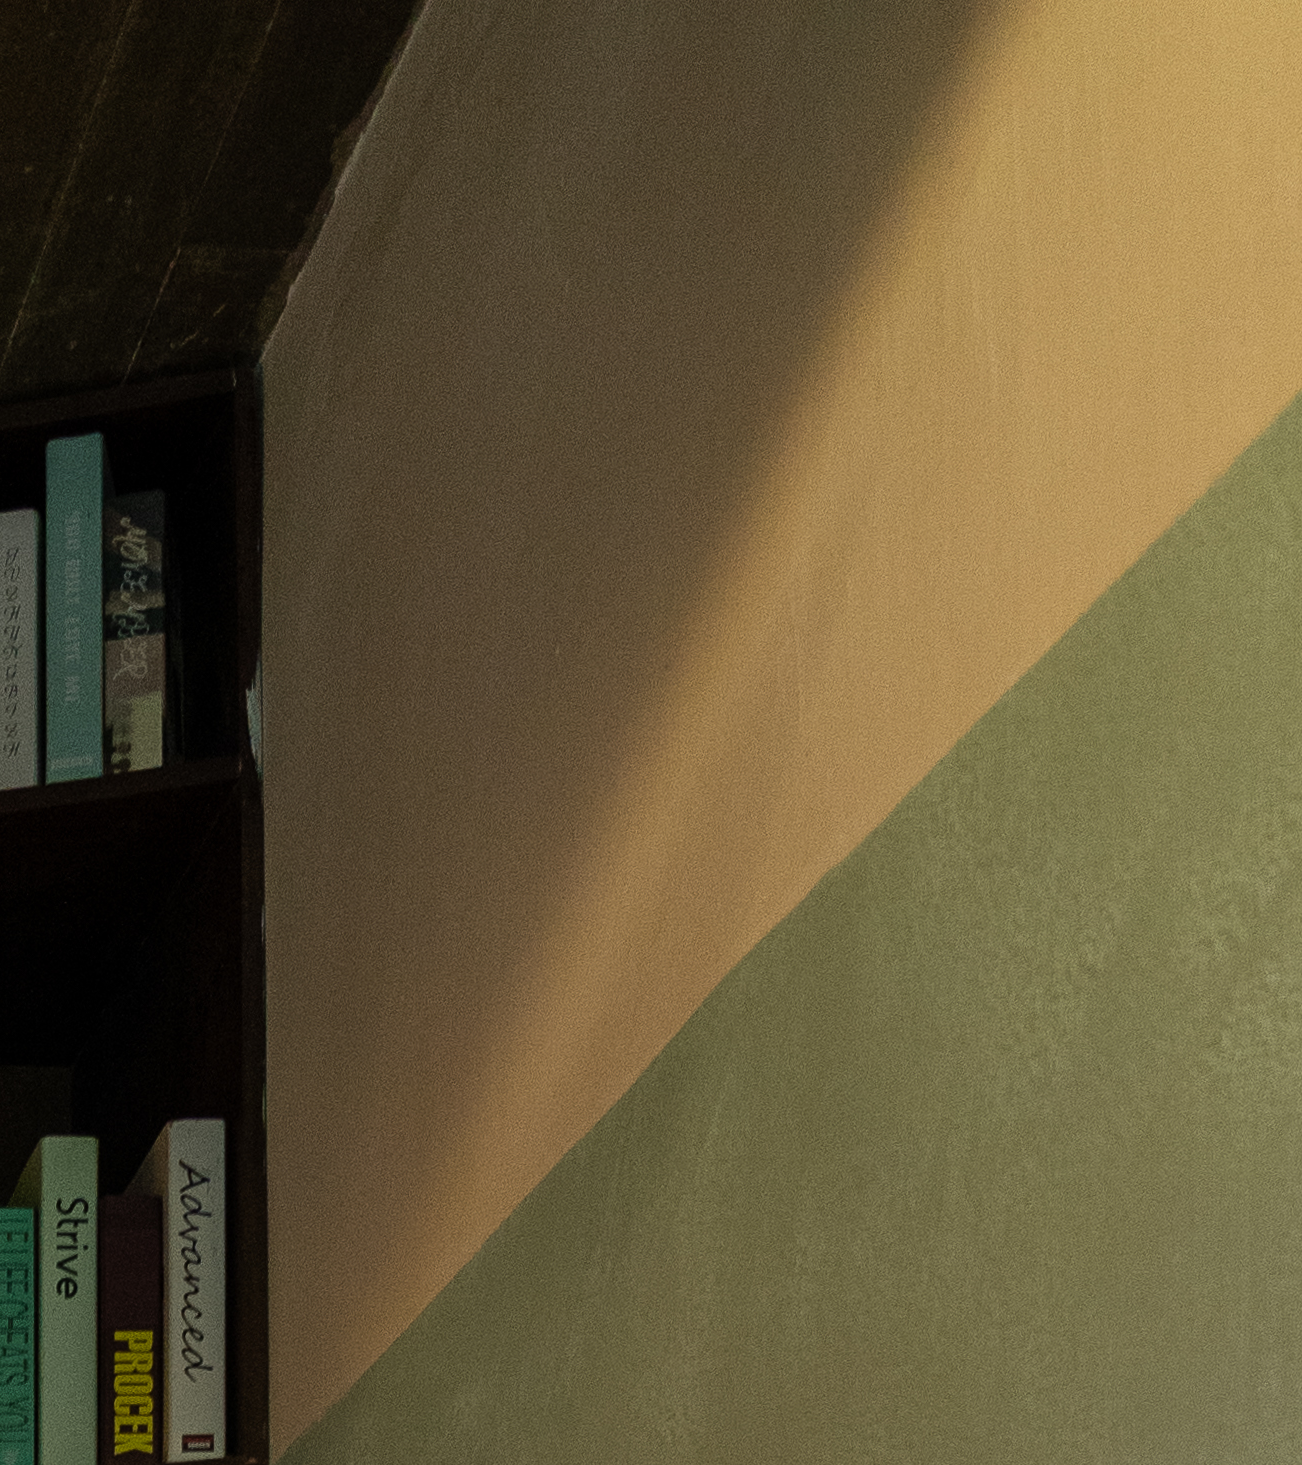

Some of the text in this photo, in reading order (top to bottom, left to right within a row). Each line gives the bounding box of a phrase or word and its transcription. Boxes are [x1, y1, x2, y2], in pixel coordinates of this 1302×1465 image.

[54, 1196, 89, 1300] Strive
[177, 1158, 214, 1384] Advanced
[112, 1329, 155, 1456] PROCEK
